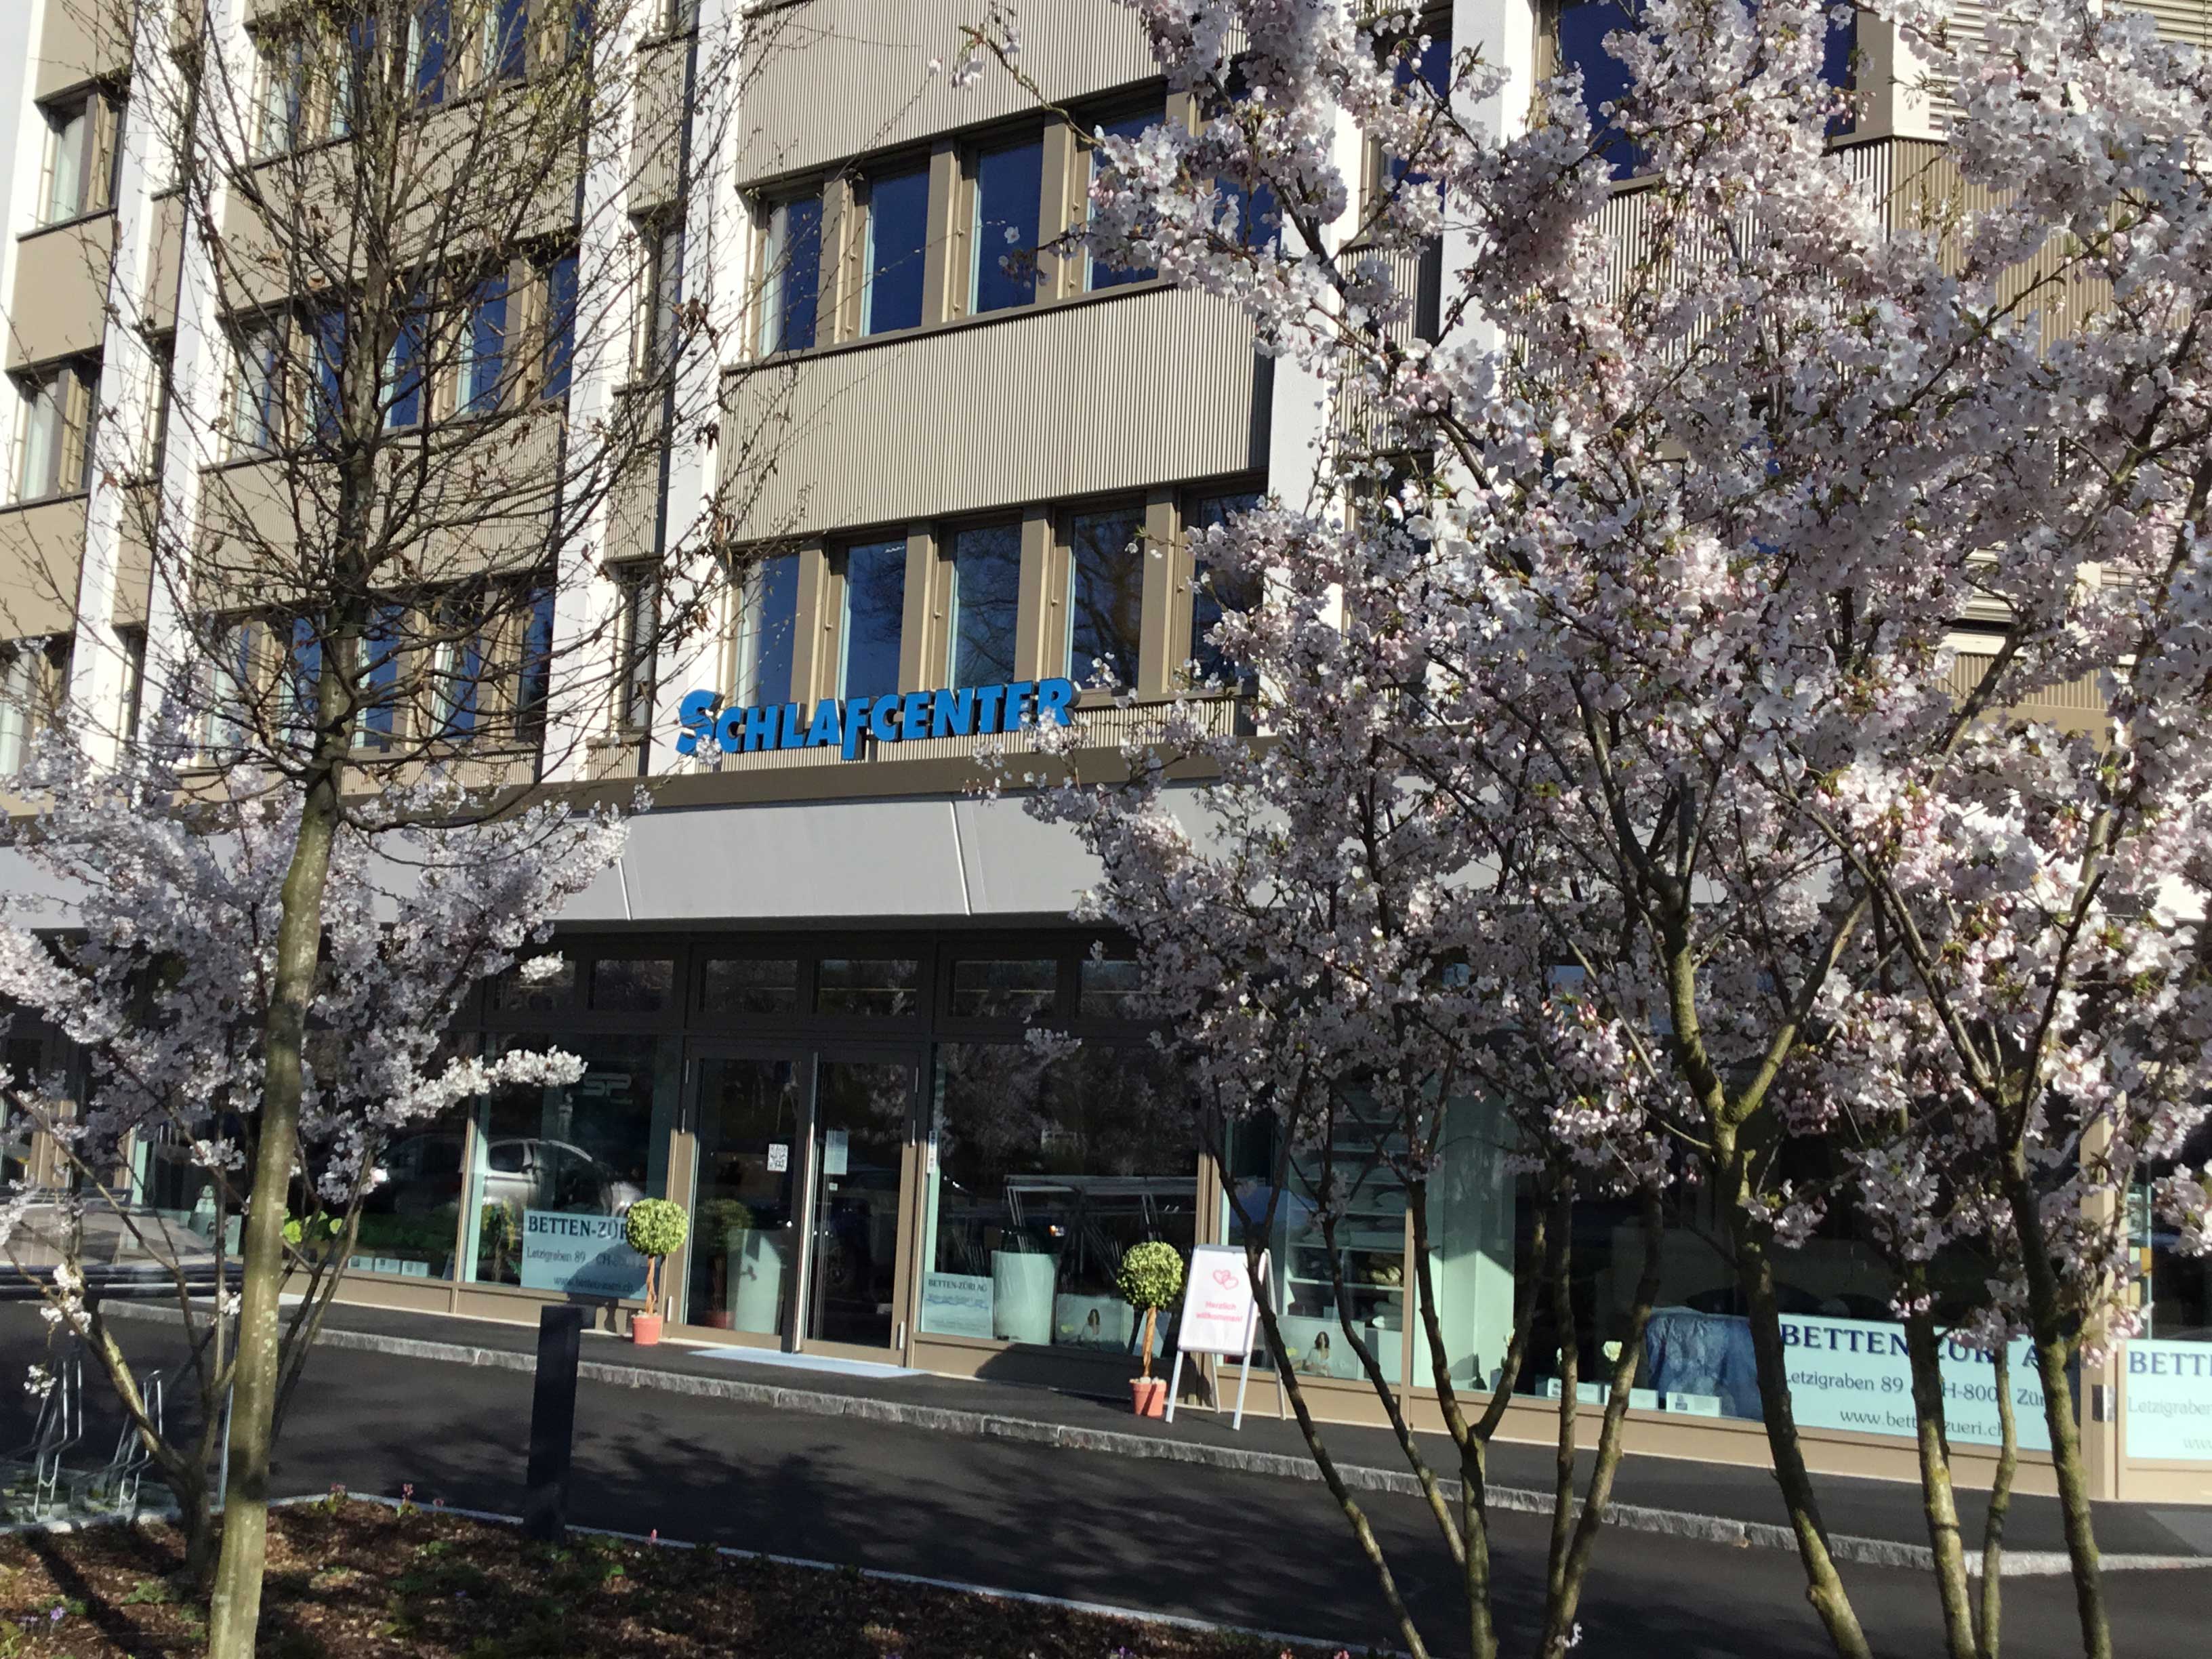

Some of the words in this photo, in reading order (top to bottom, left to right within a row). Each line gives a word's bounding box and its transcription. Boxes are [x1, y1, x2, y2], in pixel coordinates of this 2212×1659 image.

[675, 676, 1079, 760] SCHLAFCENTER
[528, 1215, 628, 1240] BETTEN-ZÜR
[574, 1250, 586, 1264] 89
[1206, 1301, 1236, 1310] Herzlich
[2129, 1351, 2212, 1376] BETT
[1787, 1370, 1875, 1390] etzigraben
[1881, 1376, 1904, 1393] 89
[1941, 1382, 1997, 1402] H-800
[2017, 1388, 2045, 1407] Zür
